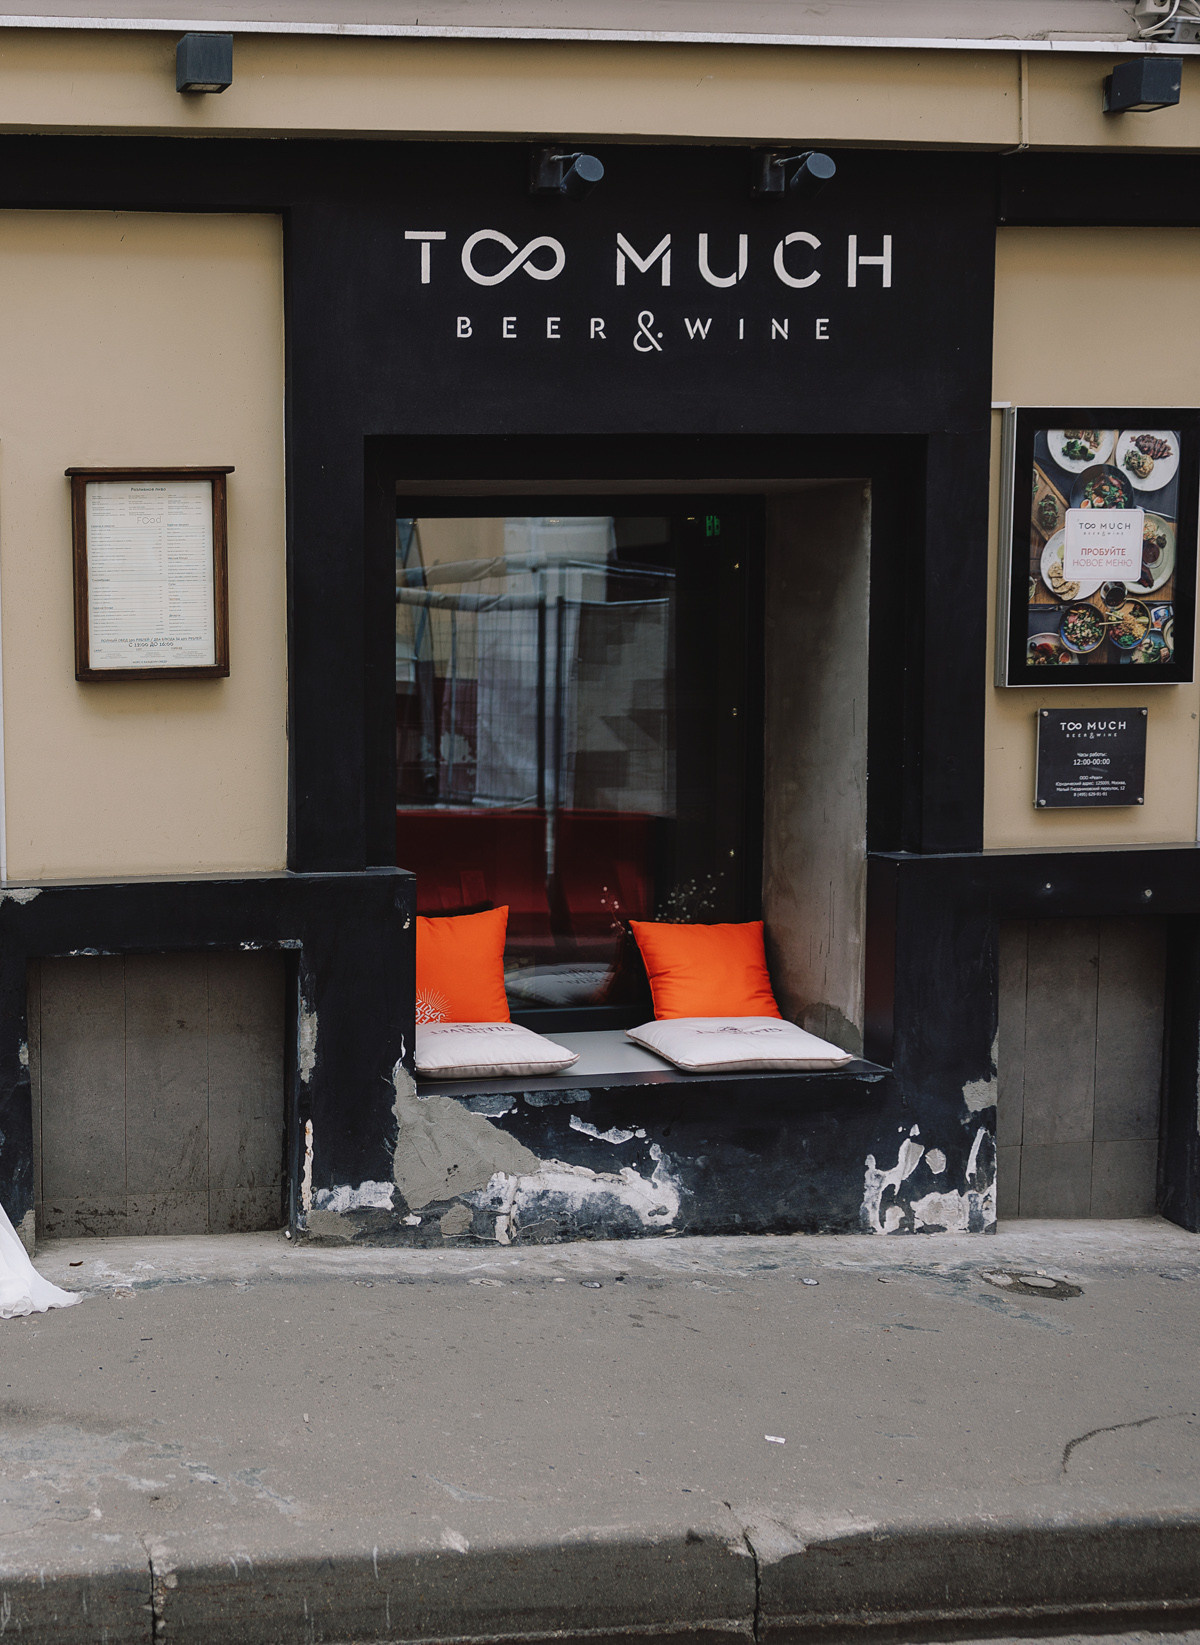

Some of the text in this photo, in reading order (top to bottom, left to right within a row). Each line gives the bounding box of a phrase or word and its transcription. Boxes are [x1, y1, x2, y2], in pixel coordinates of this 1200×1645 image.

[616, 231, 893, 289] MUCH
[1100, 522, 1131, 530] MUCH
[1080, 546, 1126, 556] ПРОБУЙТЕ
[1072, 558, 1133, 567] НОВОЕ МЕНЮ
[1087, 721, 1126, 730] MUCH
